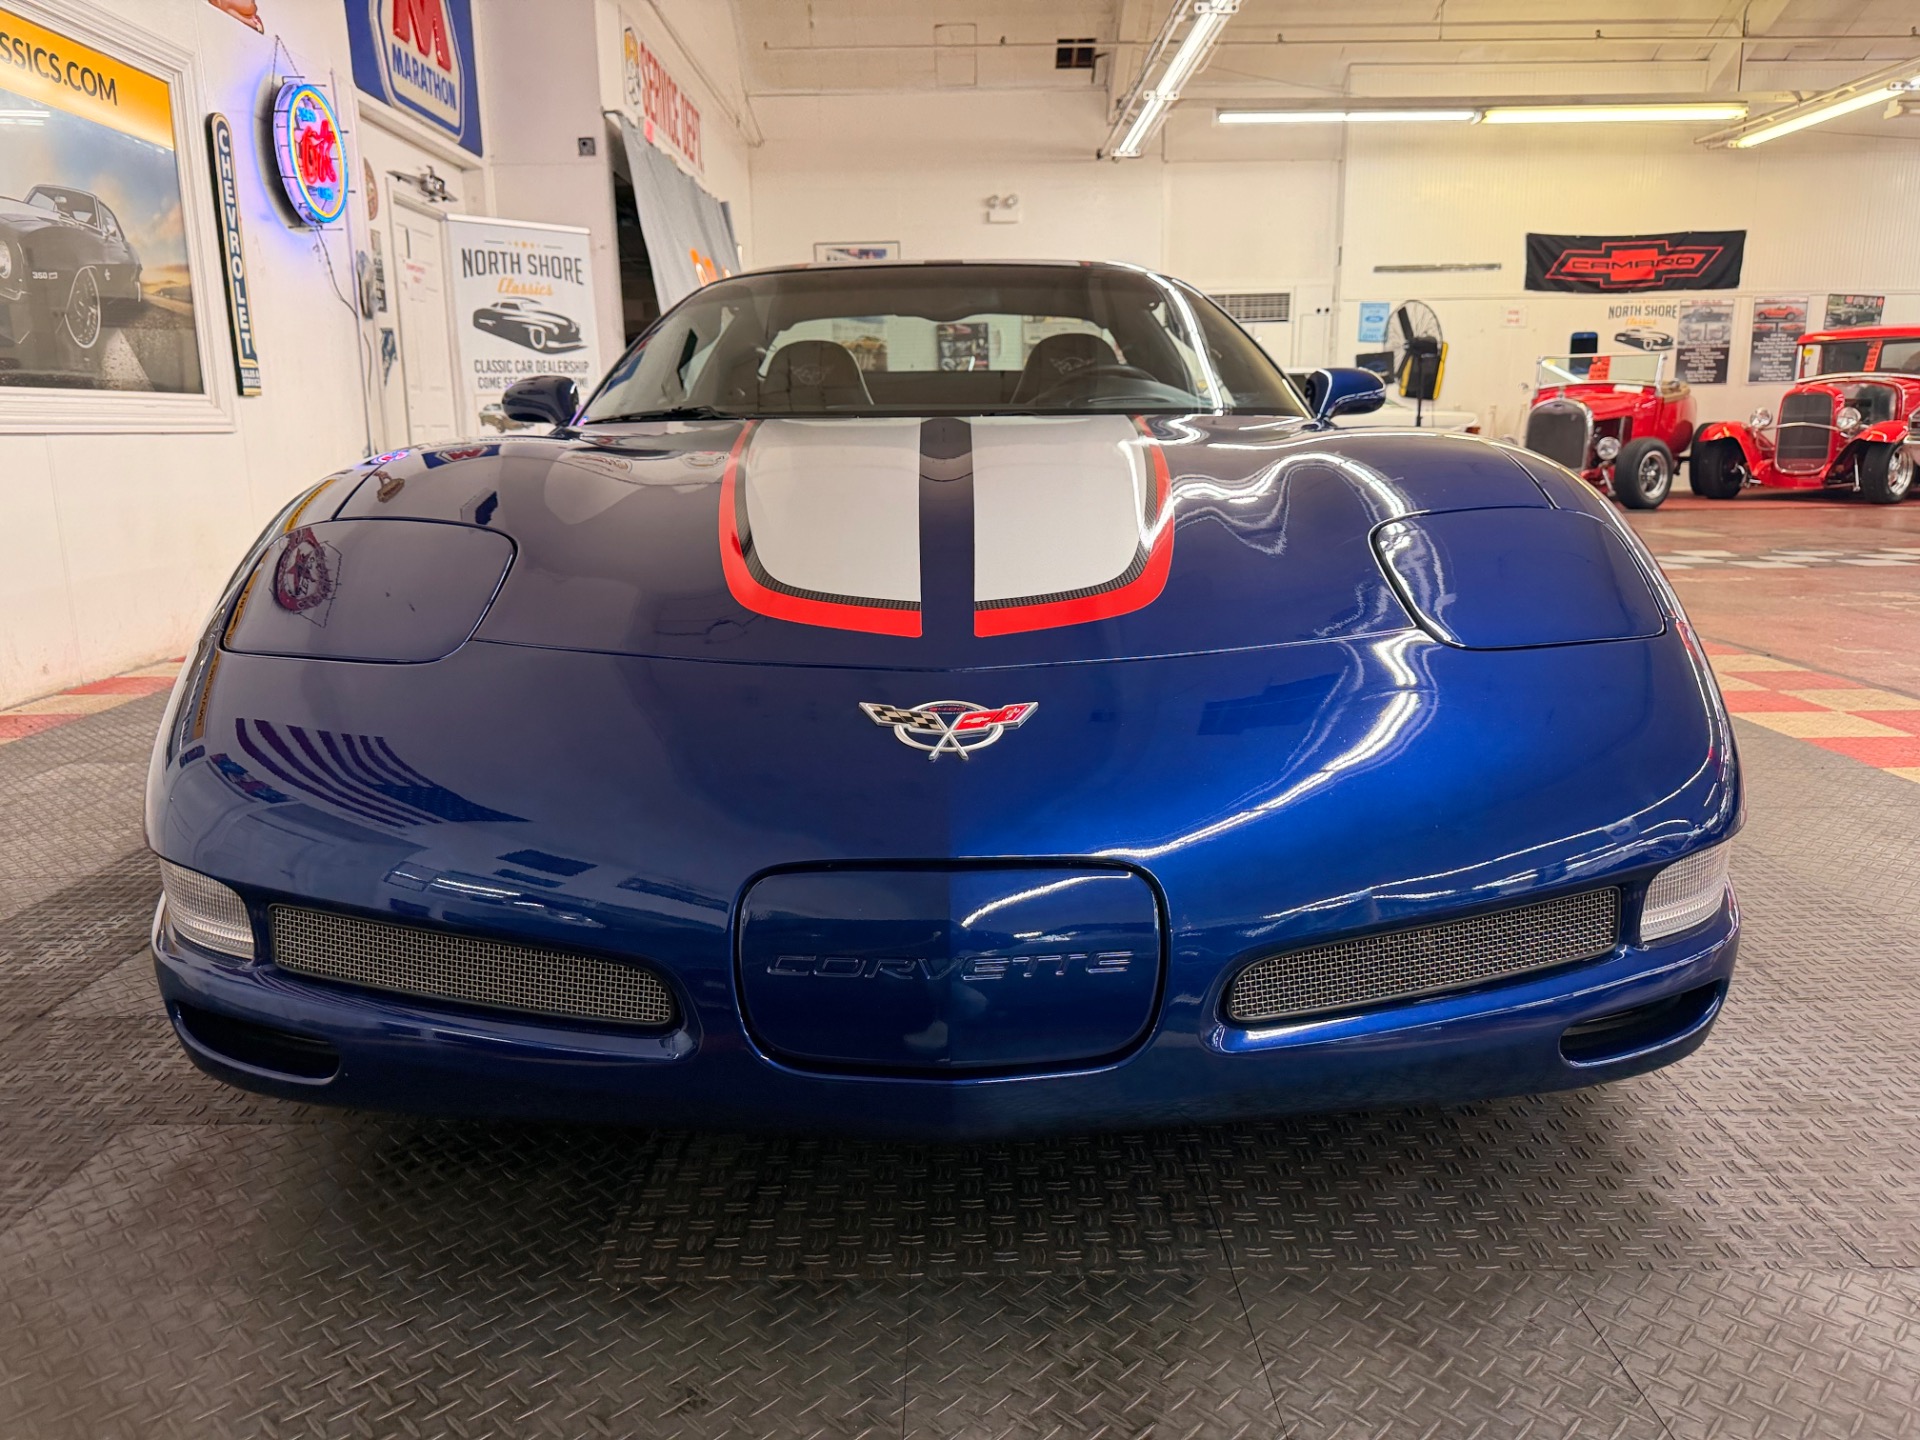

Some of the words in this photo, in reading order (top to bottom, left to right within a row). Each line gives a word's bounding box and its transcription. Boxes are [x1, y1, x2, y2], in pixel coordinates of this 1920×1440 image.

[392, 43, 457, 110] MARATHON
[218, 128, 250, 355] CHEVROLET
[461, 248, 522, 279] NORTH
[527, 253, 585, 286] SHORE
[1572, 256, 1696, 271] CAMARO
[496, 277, 554, 297] Classics
[1607, 304, 1642, 319] NORTH
[1644, 304, 1678, 319] SHORE
[474, 359, 513, 374] CLASSIC
[515, 360, 534, 374] CAR
[535, 360, 590, 374] DEALERSHIP
[477, 376, 501, 389] COME
[766, 950, 1134, 981] CORVETTE
